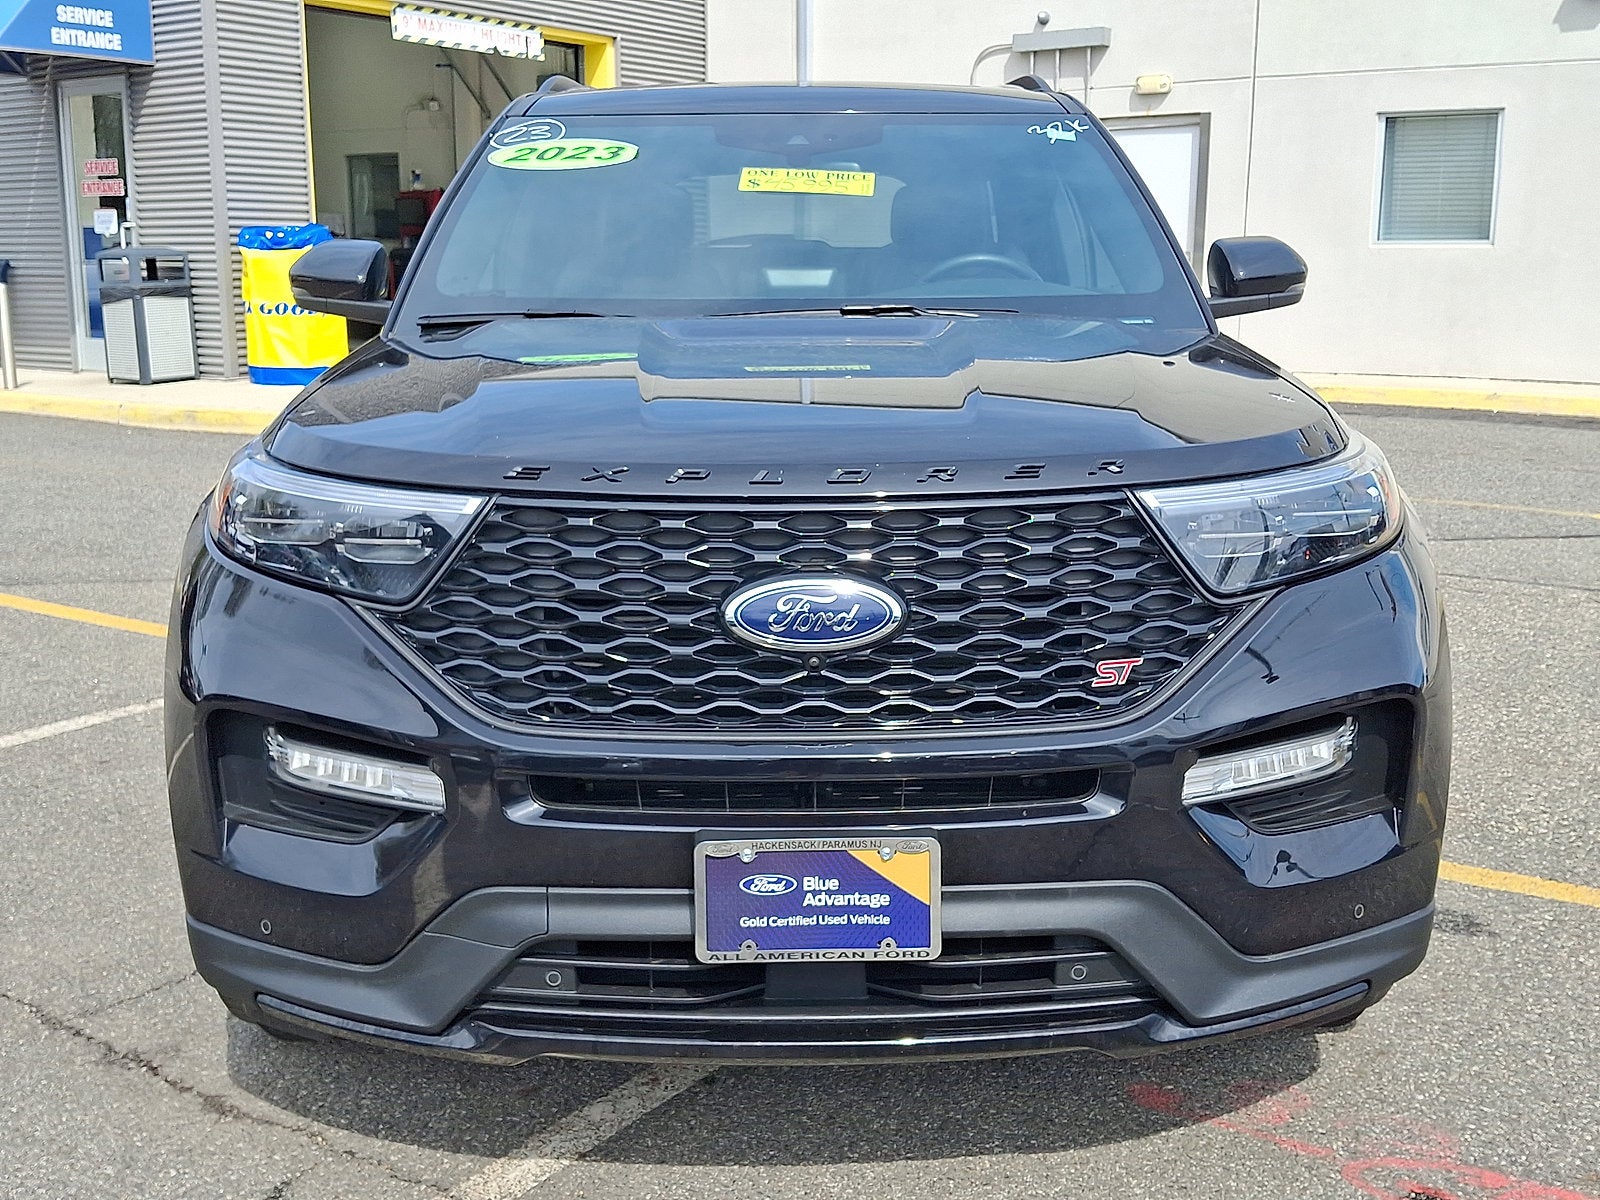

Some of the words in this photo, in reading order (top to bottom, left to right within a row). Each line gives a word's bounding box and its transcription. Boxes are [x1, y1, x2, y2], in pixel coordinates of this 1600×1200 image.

[56, 4, 114, 28] SERVICE
[50, 26, 122, 51] ENTRANCE
[503, 125, 552, 143] 23
[503, 146, 626, 162] 2023
[84, 161, 118, 174] SERVICE
[747, 169, 779, 177] ONE
[786, 170, 818, 179] LOW
[826, 172, 872, 181] PRICE
[81, 181, 123, 193] ENTRANCE
[502, 458, 1126, 486] EXPLORER
[768, 593, 860, 633] Ford
[1091, 657, 1145, 688] ST
[869, 840, 882, 849] NJ
[750, 876, 786, 892] Ford
[802, 876, 840, 891] Blue
[802, 892, 890, 908] Advantage
[739, 916, 767, 928] Gold
[768, 915, 817, 926] Certified
[818, 914, 848, 925] Used
[849, 914, 891, 925] Vehicle
[708, 953, 747, 961] ALL
[753, 951, 865, 960] AMERICAN
[873, 950, 931, 959] FORD
